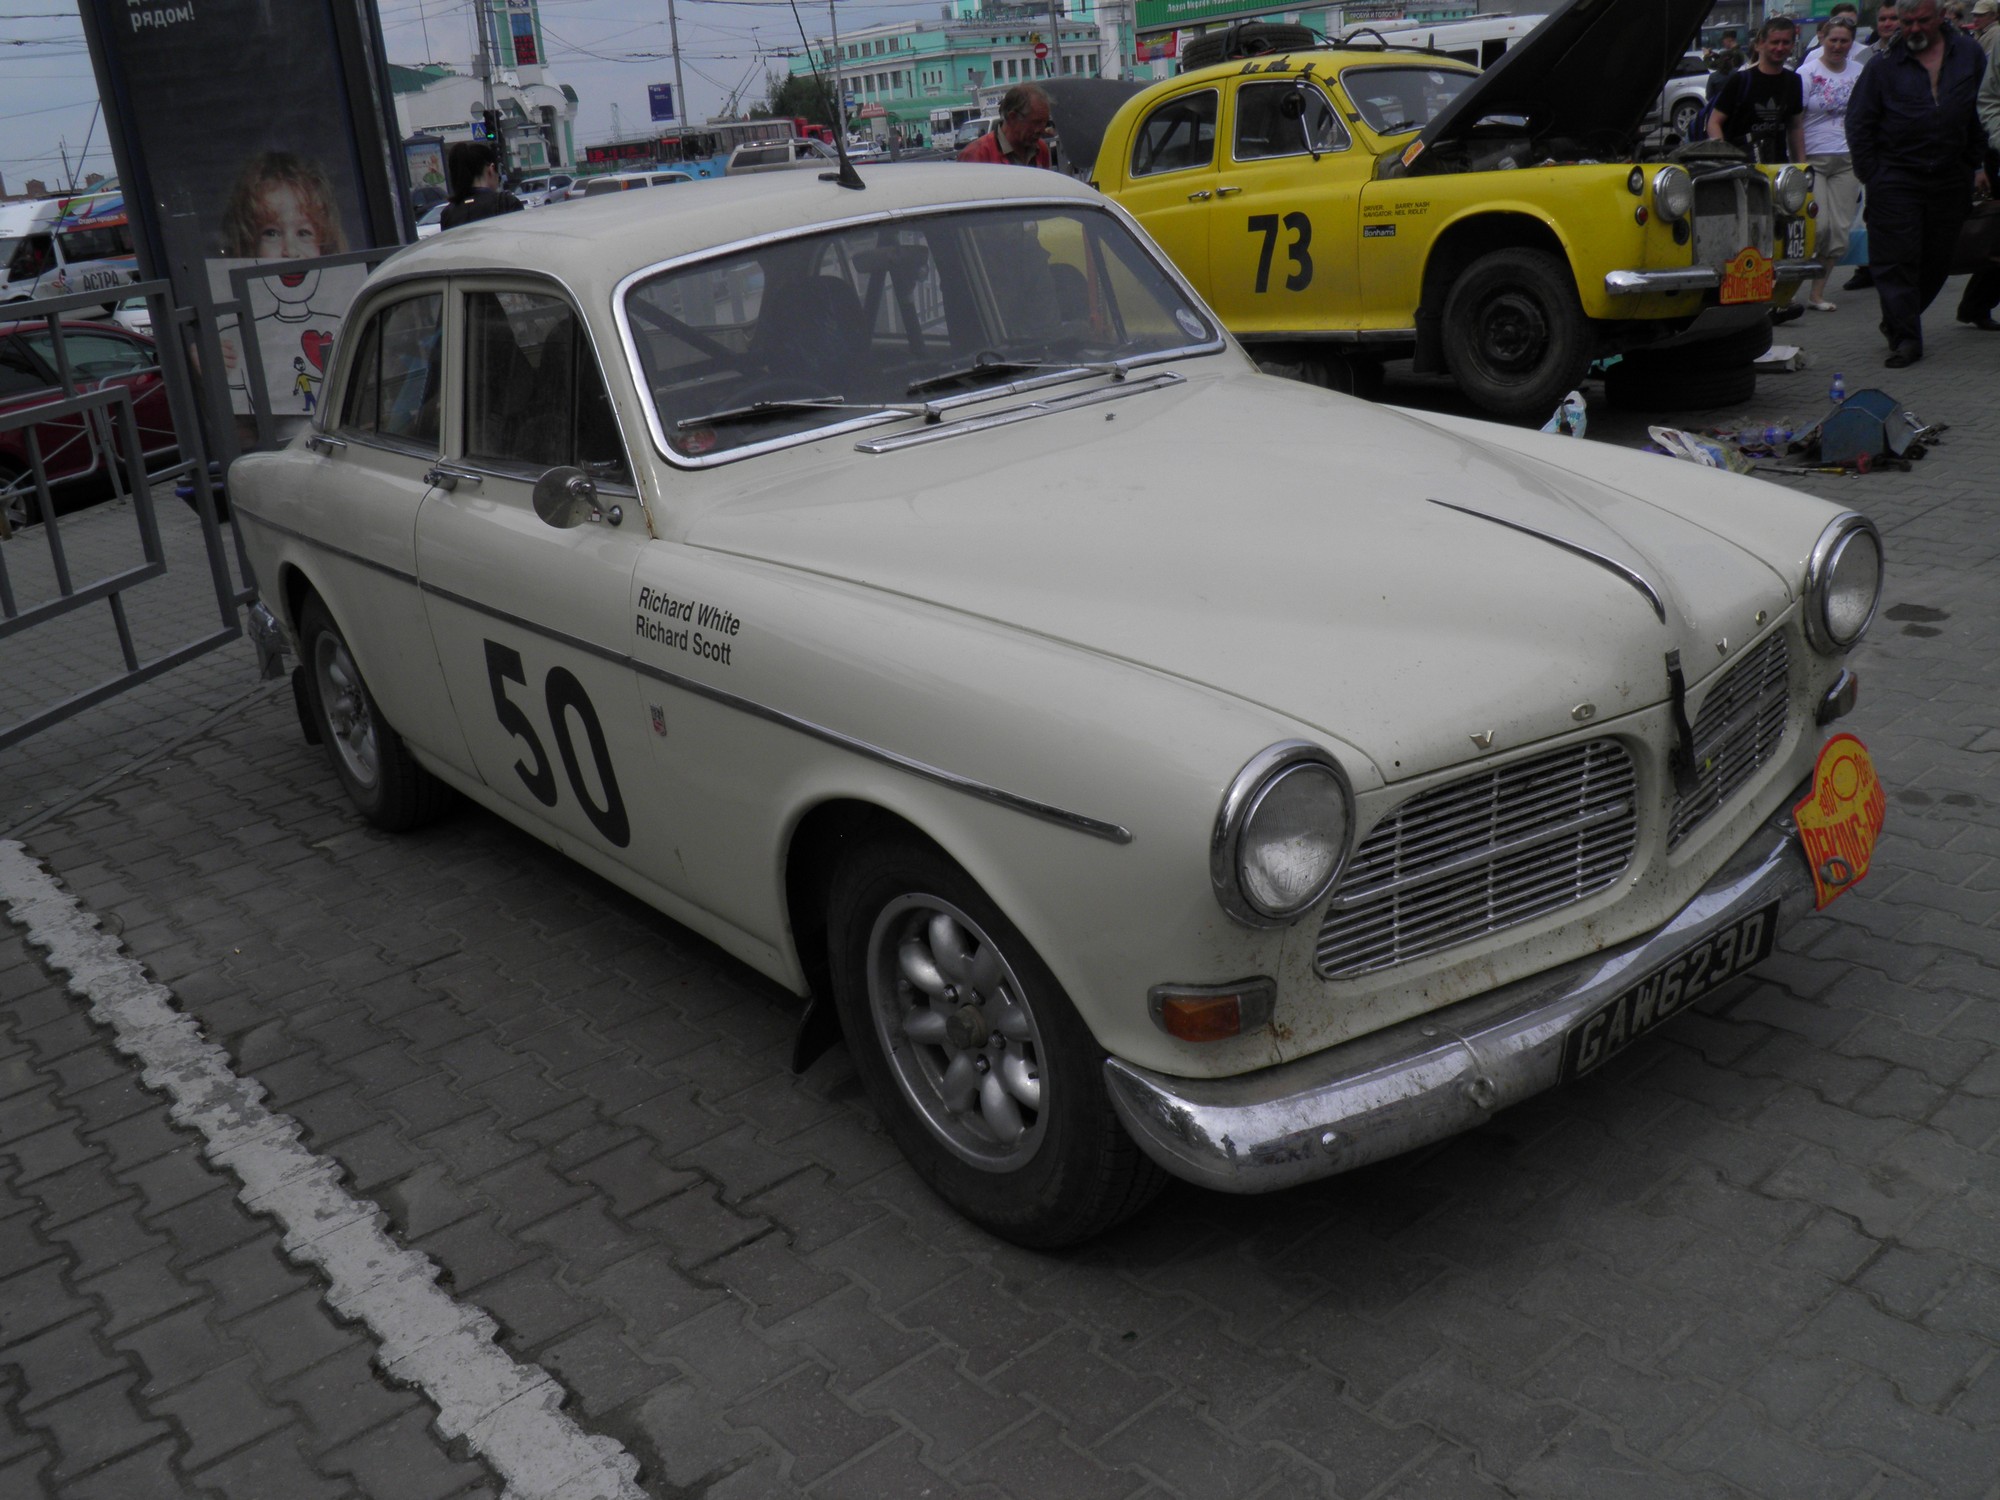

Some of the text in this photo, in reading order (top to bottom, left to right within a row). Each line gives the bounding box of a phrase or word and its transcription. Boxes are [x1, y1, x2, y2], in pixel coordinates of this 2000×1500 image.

[131, 1, 196, 33] рядом!
[1364, 229, 1395, 237] Bonhams
[1787, 239, 1805, 258] 405
[1788, 220, 1805, 239] VCY
[1248, 211, 1314, 293] 73
[83, 270, 119, 291] АСТРА
[638, 586, 741, 637] Richard White
[636, 614, 732, 666] Richard Scott
[483, 637, 631, 849] 50
[1576, 911, 1766, 1073] GAW623D
